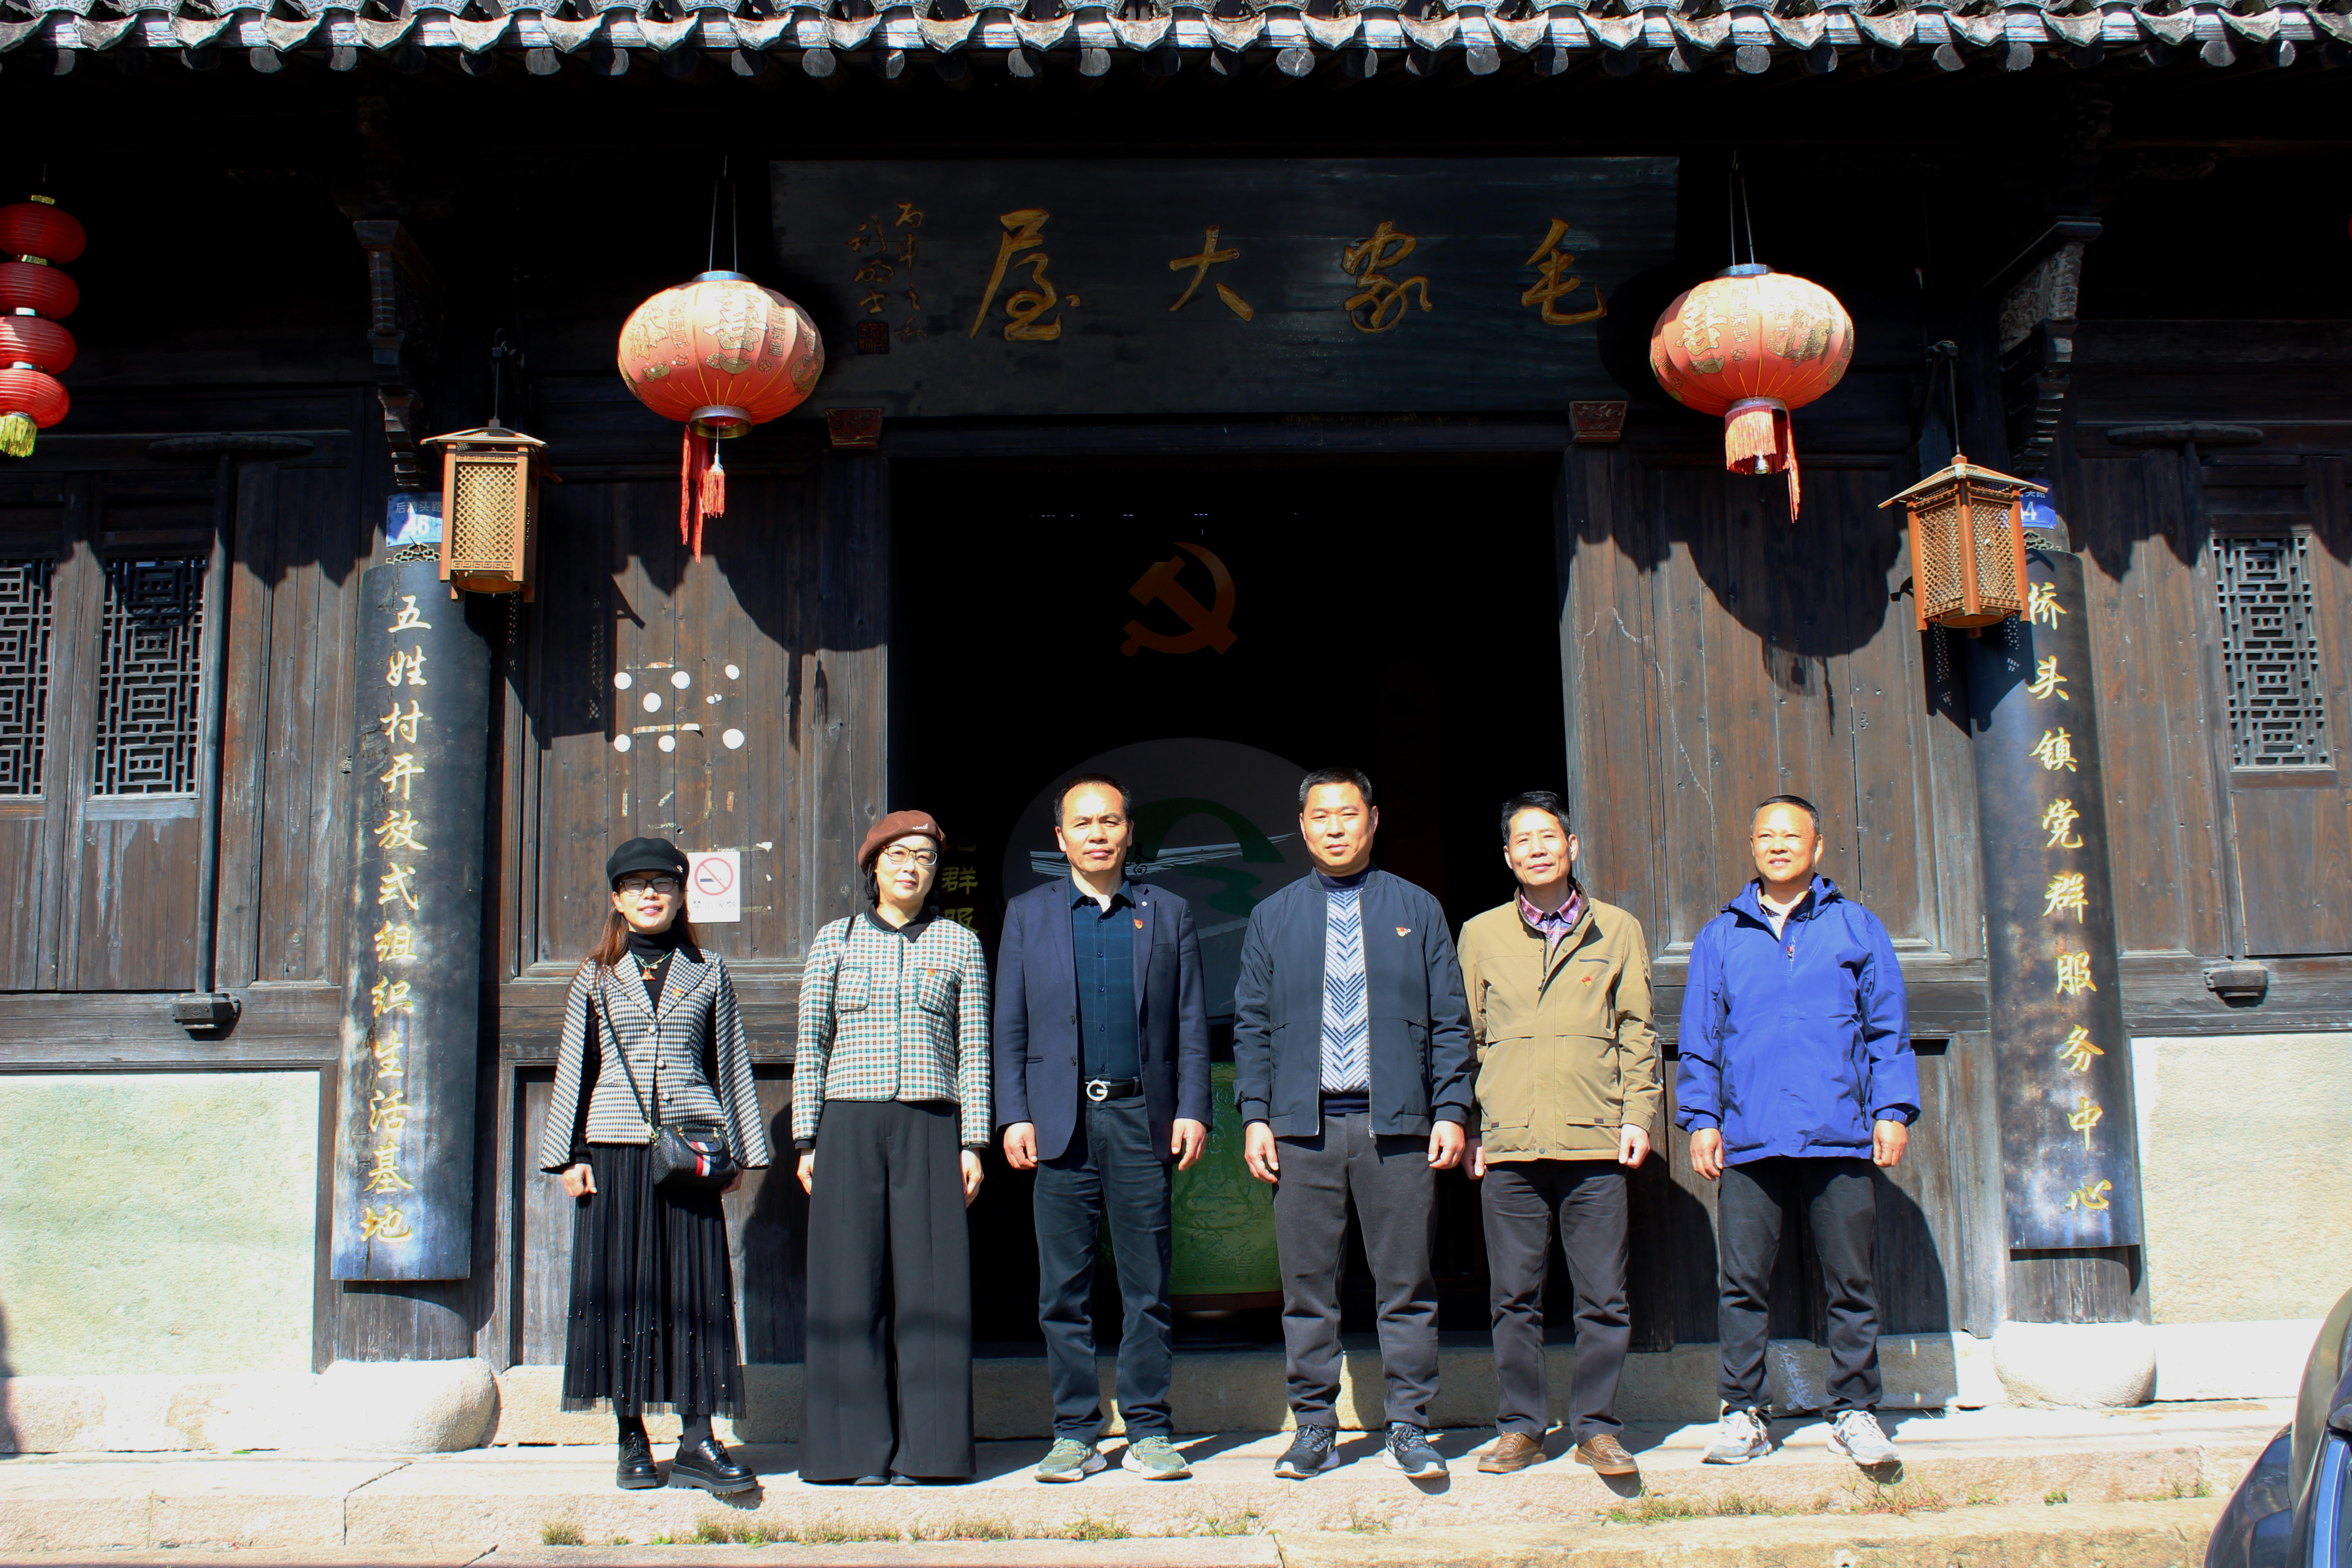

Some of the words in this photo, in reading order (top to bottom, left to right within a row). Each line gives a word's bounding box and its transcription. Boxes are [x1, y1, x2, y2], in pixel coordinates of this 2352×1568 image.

[969, 208, 1607, 341] 毛家大屋
[360, 595, 432, 1242] 五姓村开放式组织生活基地
[2027, 582, 2112, 1210] 桥头镇党群服务中心
